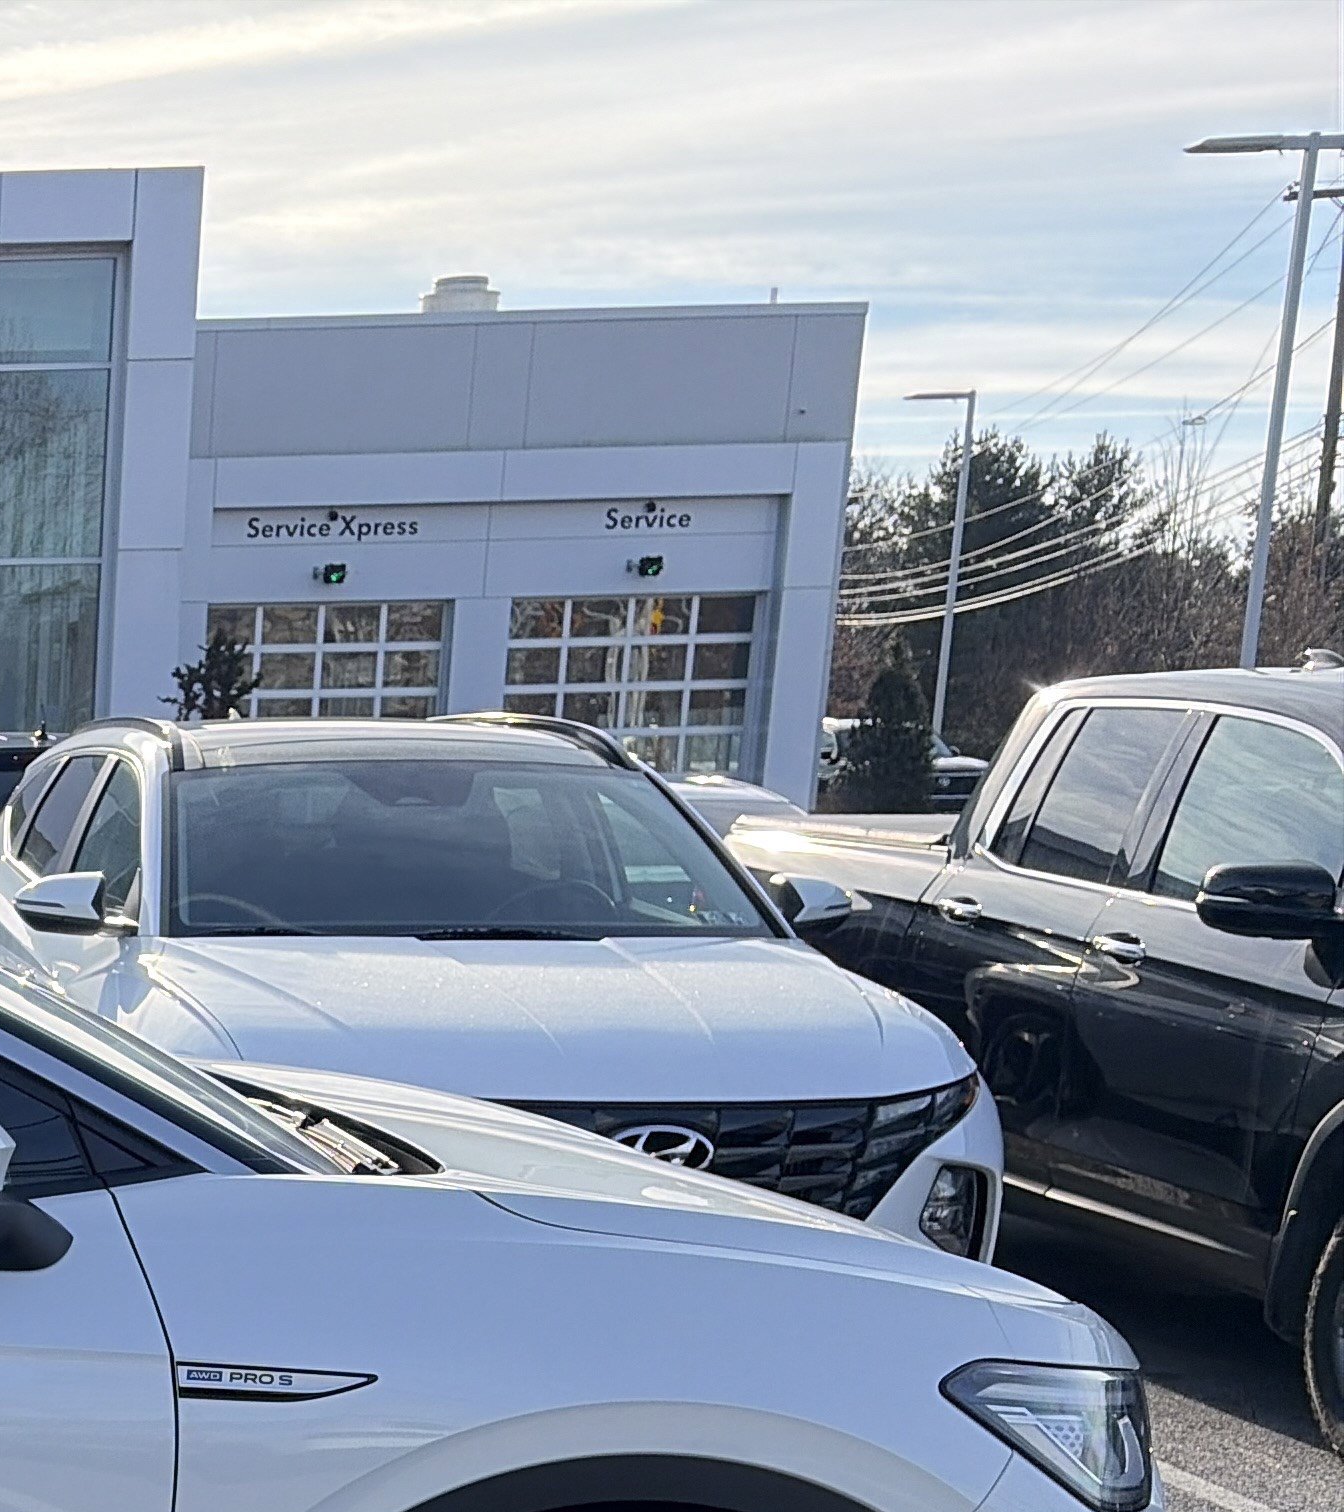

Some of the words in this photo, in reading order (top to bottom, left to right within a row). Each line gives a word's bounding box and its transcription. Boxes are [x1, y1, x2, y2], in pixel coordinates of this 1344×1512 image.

[246, 516, 331, 539] Service
[338, 514, 419, 542] Xpress
[604, 507, 692, 530] Service
[188, 1370, 222, 1382] AWD
[229, 1371, 275, 1385] PRO
[278, 1374, 293, 1386] S
